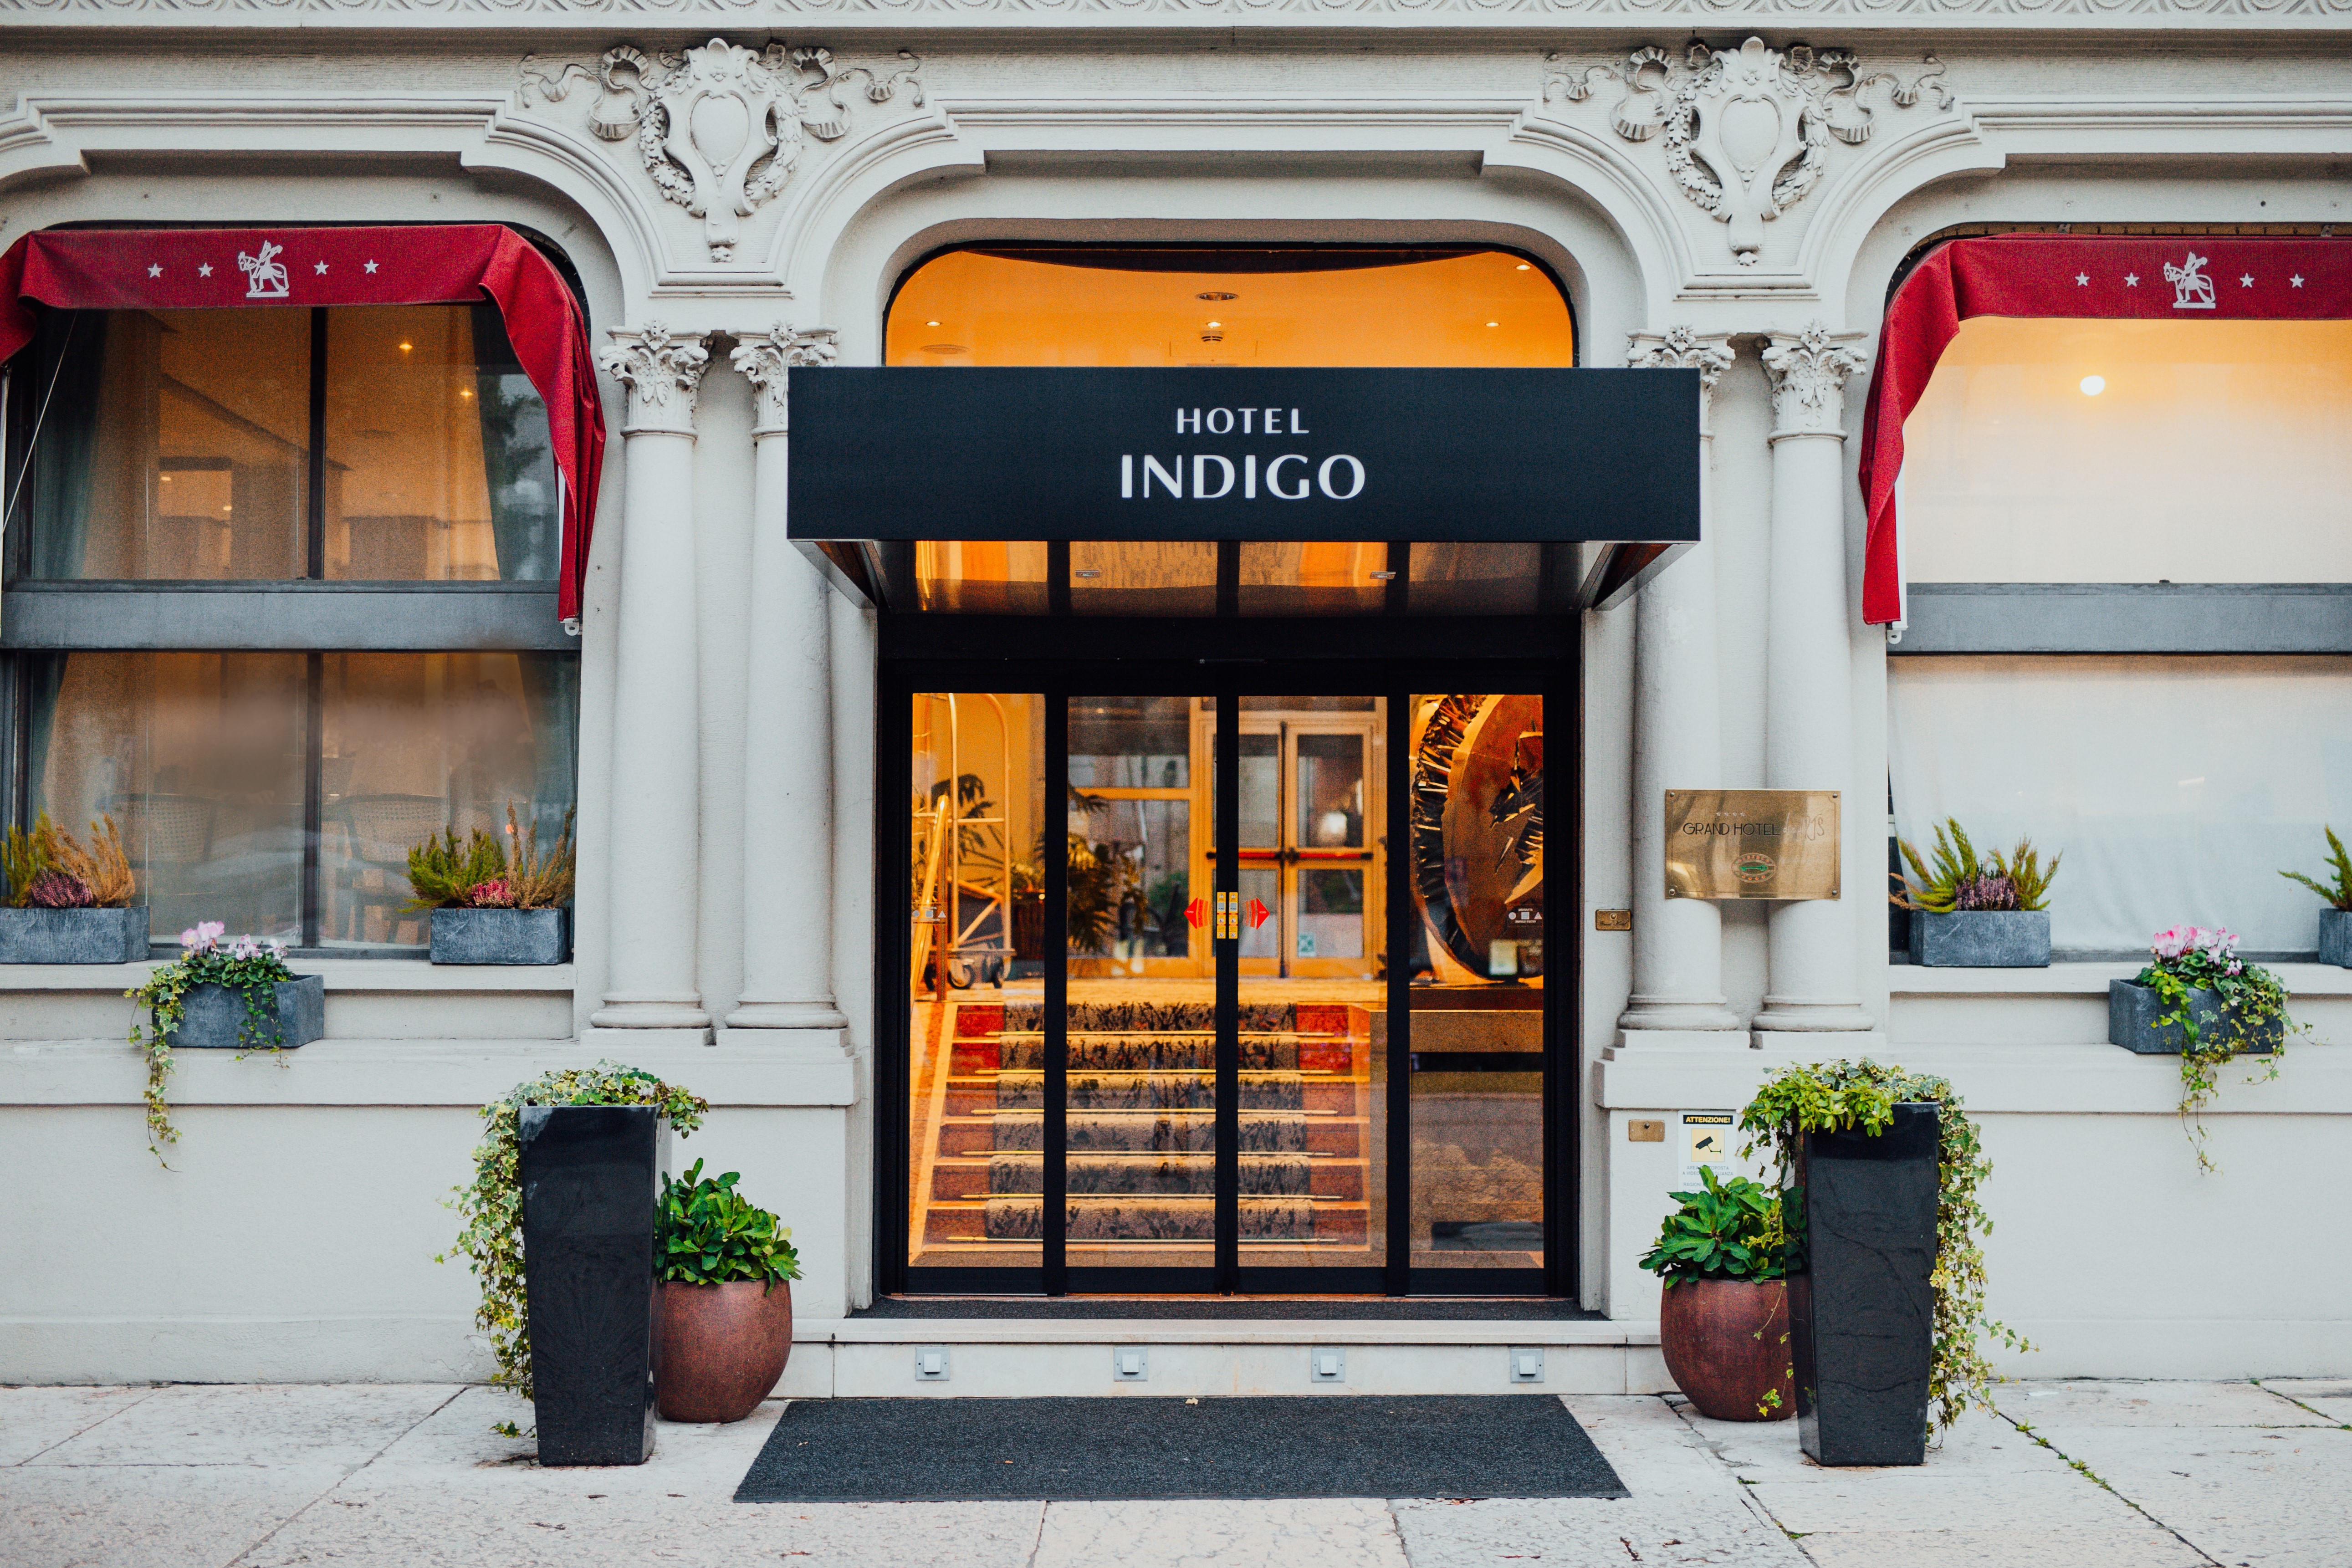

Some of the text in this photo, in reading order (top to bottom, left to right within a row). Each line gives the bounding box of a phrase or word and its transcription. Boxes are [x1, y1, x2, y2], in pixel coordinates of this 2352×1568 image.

[1176, 408, 1309, 434] HOTEL
[1121, 454, 1365, 499] INDIGO
[1683, 822, 1729, 835] GRAND
[1733, 822, 1780, 836] HOTEL
